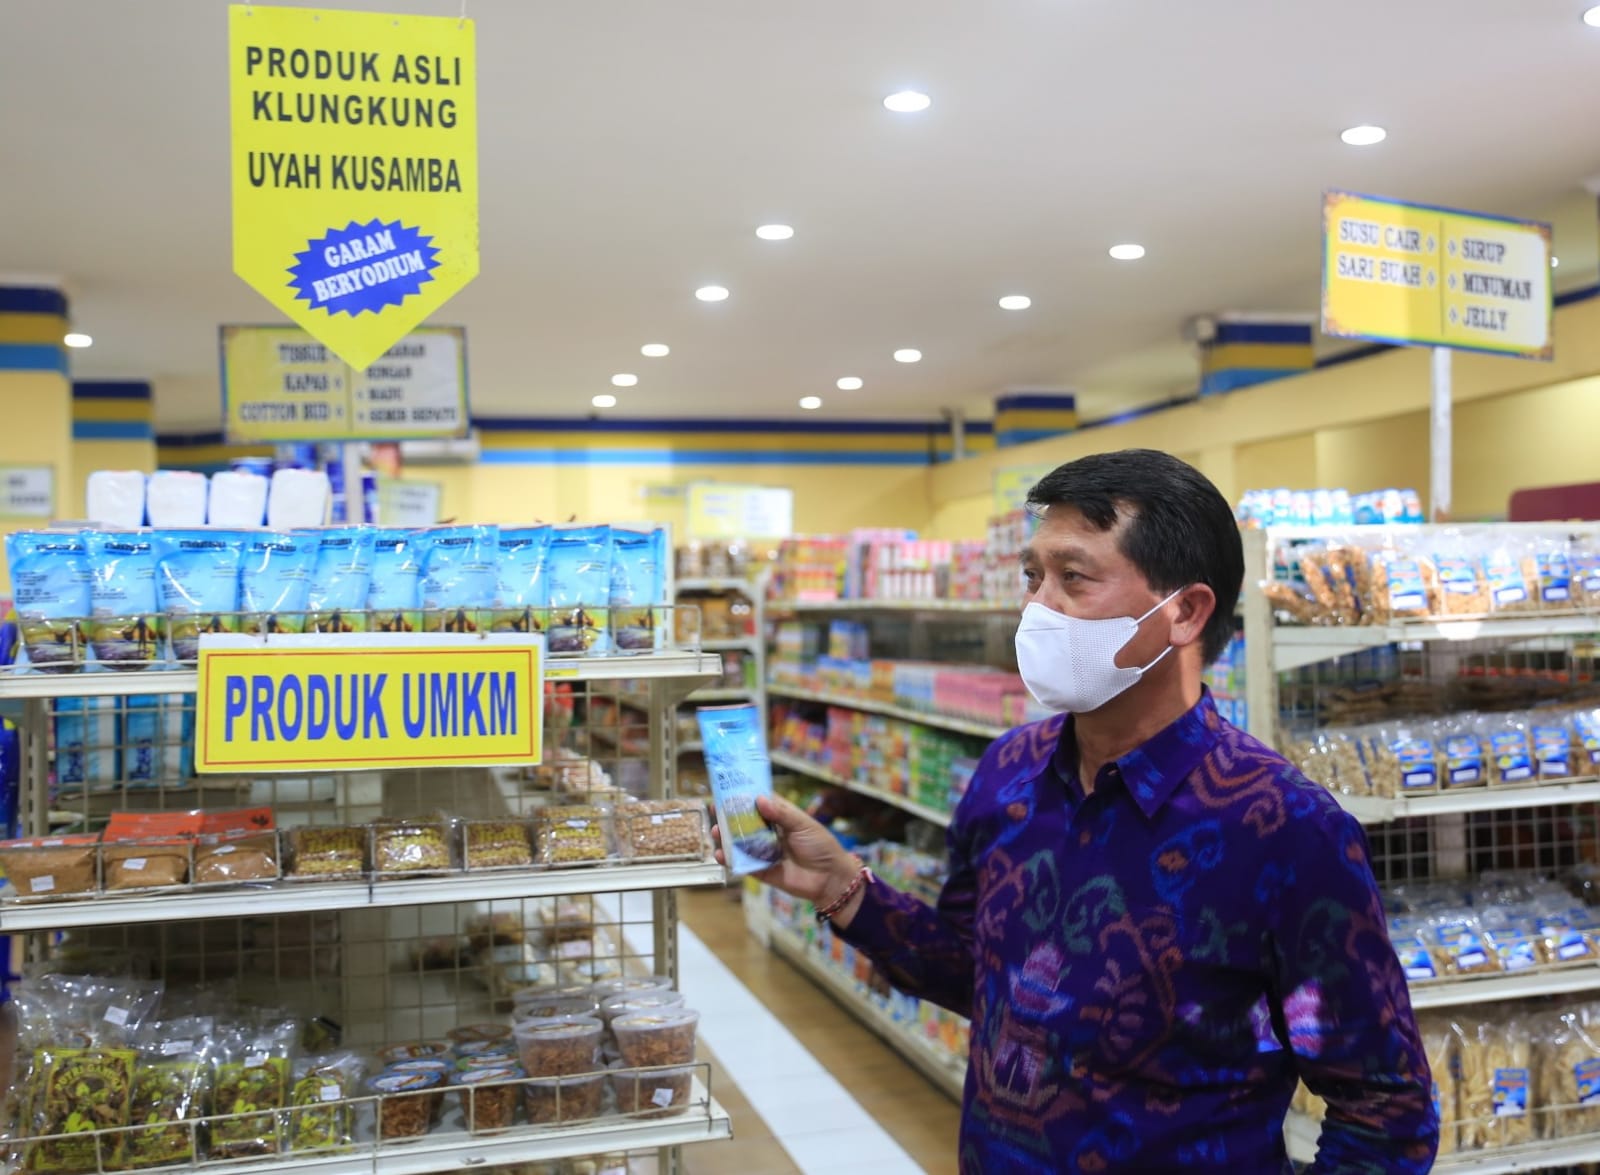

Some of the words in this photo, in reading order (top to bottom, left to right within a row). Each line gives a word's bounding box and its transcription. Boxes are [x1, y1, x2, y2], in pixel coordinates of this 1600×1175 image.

[246, 46, 380, 82] PRODUK
[392, 55, 461, 86] ASLI
[253, 91, 457, 128] KLUNGKUNG
[248, 152, 321, 189] UYAH
[332, 155, 462, 192] KUSAMBA
[324, 230, 396, 268] GARAM
[1339, 220, 1378, 245] SUSU
[1385, 227, 1421, 251] CAIR
[1462, 237, 1507, 264] SIRUP
[312, 250, 425, 302] BERYODIUM
[1337, 255, 1374, 279] SARI
[1380, 260, 1421, 286] BUAH
[1462, 272, 1532, 300] MINUMAN
[1462, 306, 1508, 331] JELLY
[224, 673, 389, 742] PRODUK
[402, 671, 517, 739] UMKM
